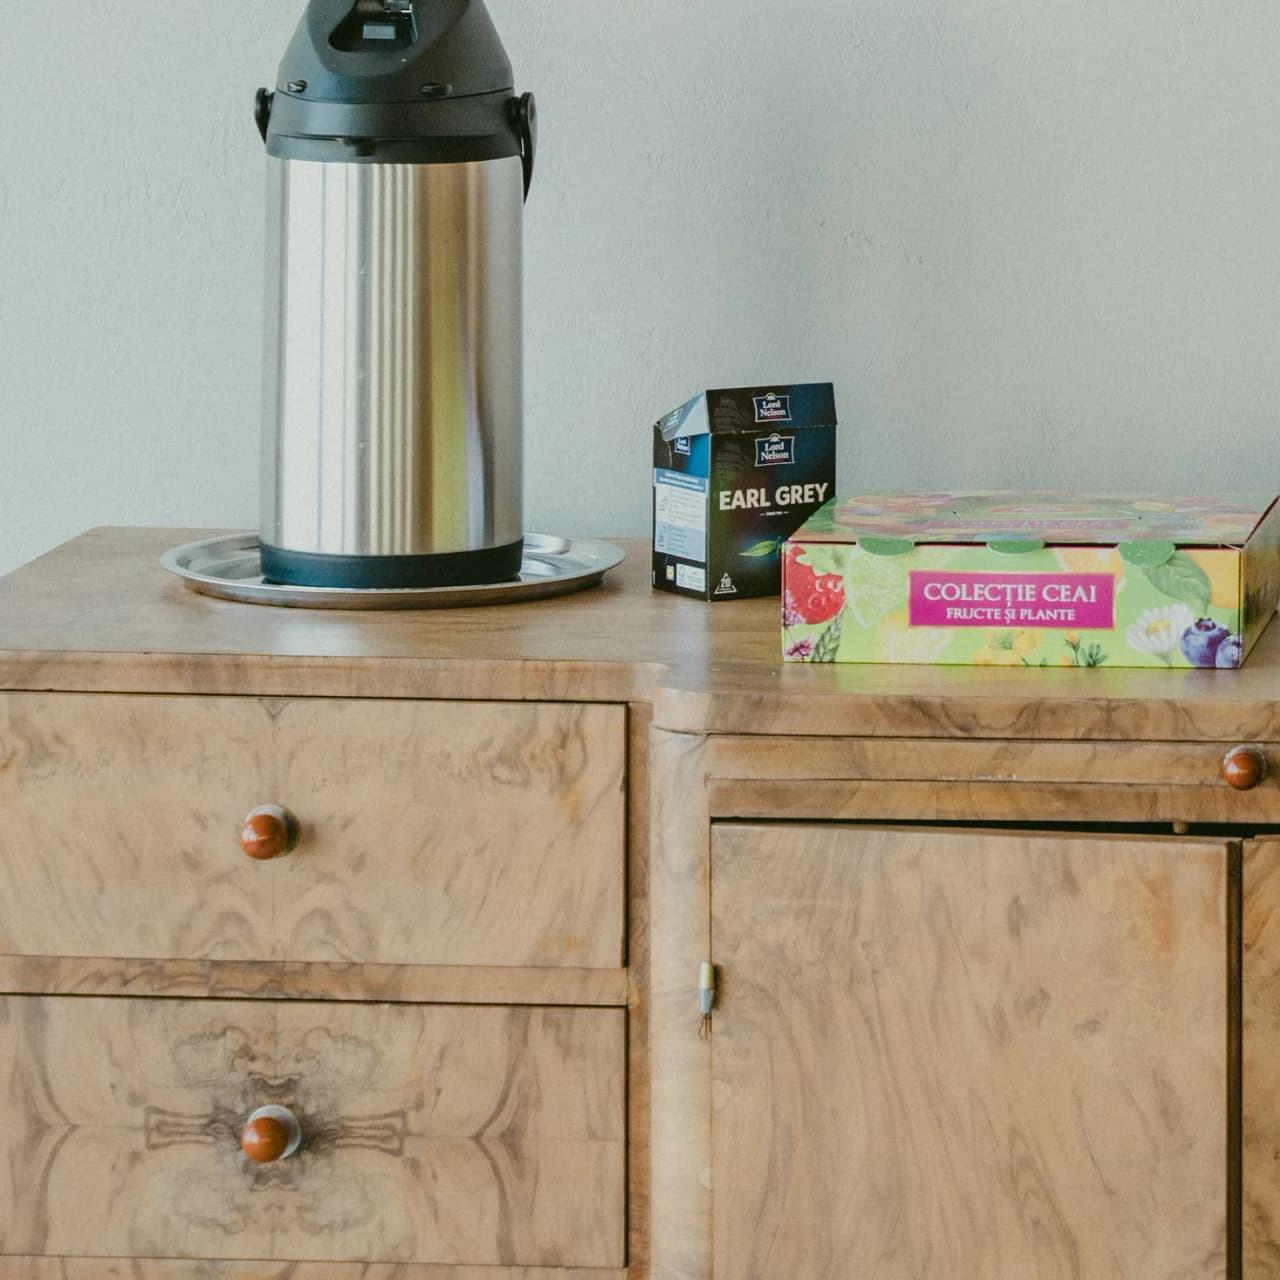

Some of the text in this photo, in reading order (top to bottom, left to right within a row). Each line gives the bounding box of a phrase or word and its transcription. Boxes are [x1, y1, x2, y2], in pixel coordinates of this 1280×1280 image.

[762, 400, 781, 409] Lord
[760, 408, 786, 417] Nelson
[764, 441, 784, 451] Lord
[760, 451, 789, 461] Nelson
[719, 488, 771, 511] EARL
[774, 482, 829, 506] GREY
[720, 577, 732, 588] 20
[924, 582, 1097, 607] COLECȚIE CEAI
[946, 607, 1002, 620] FRUCTE
[1019, 608, 1075, 620] PLANTE
